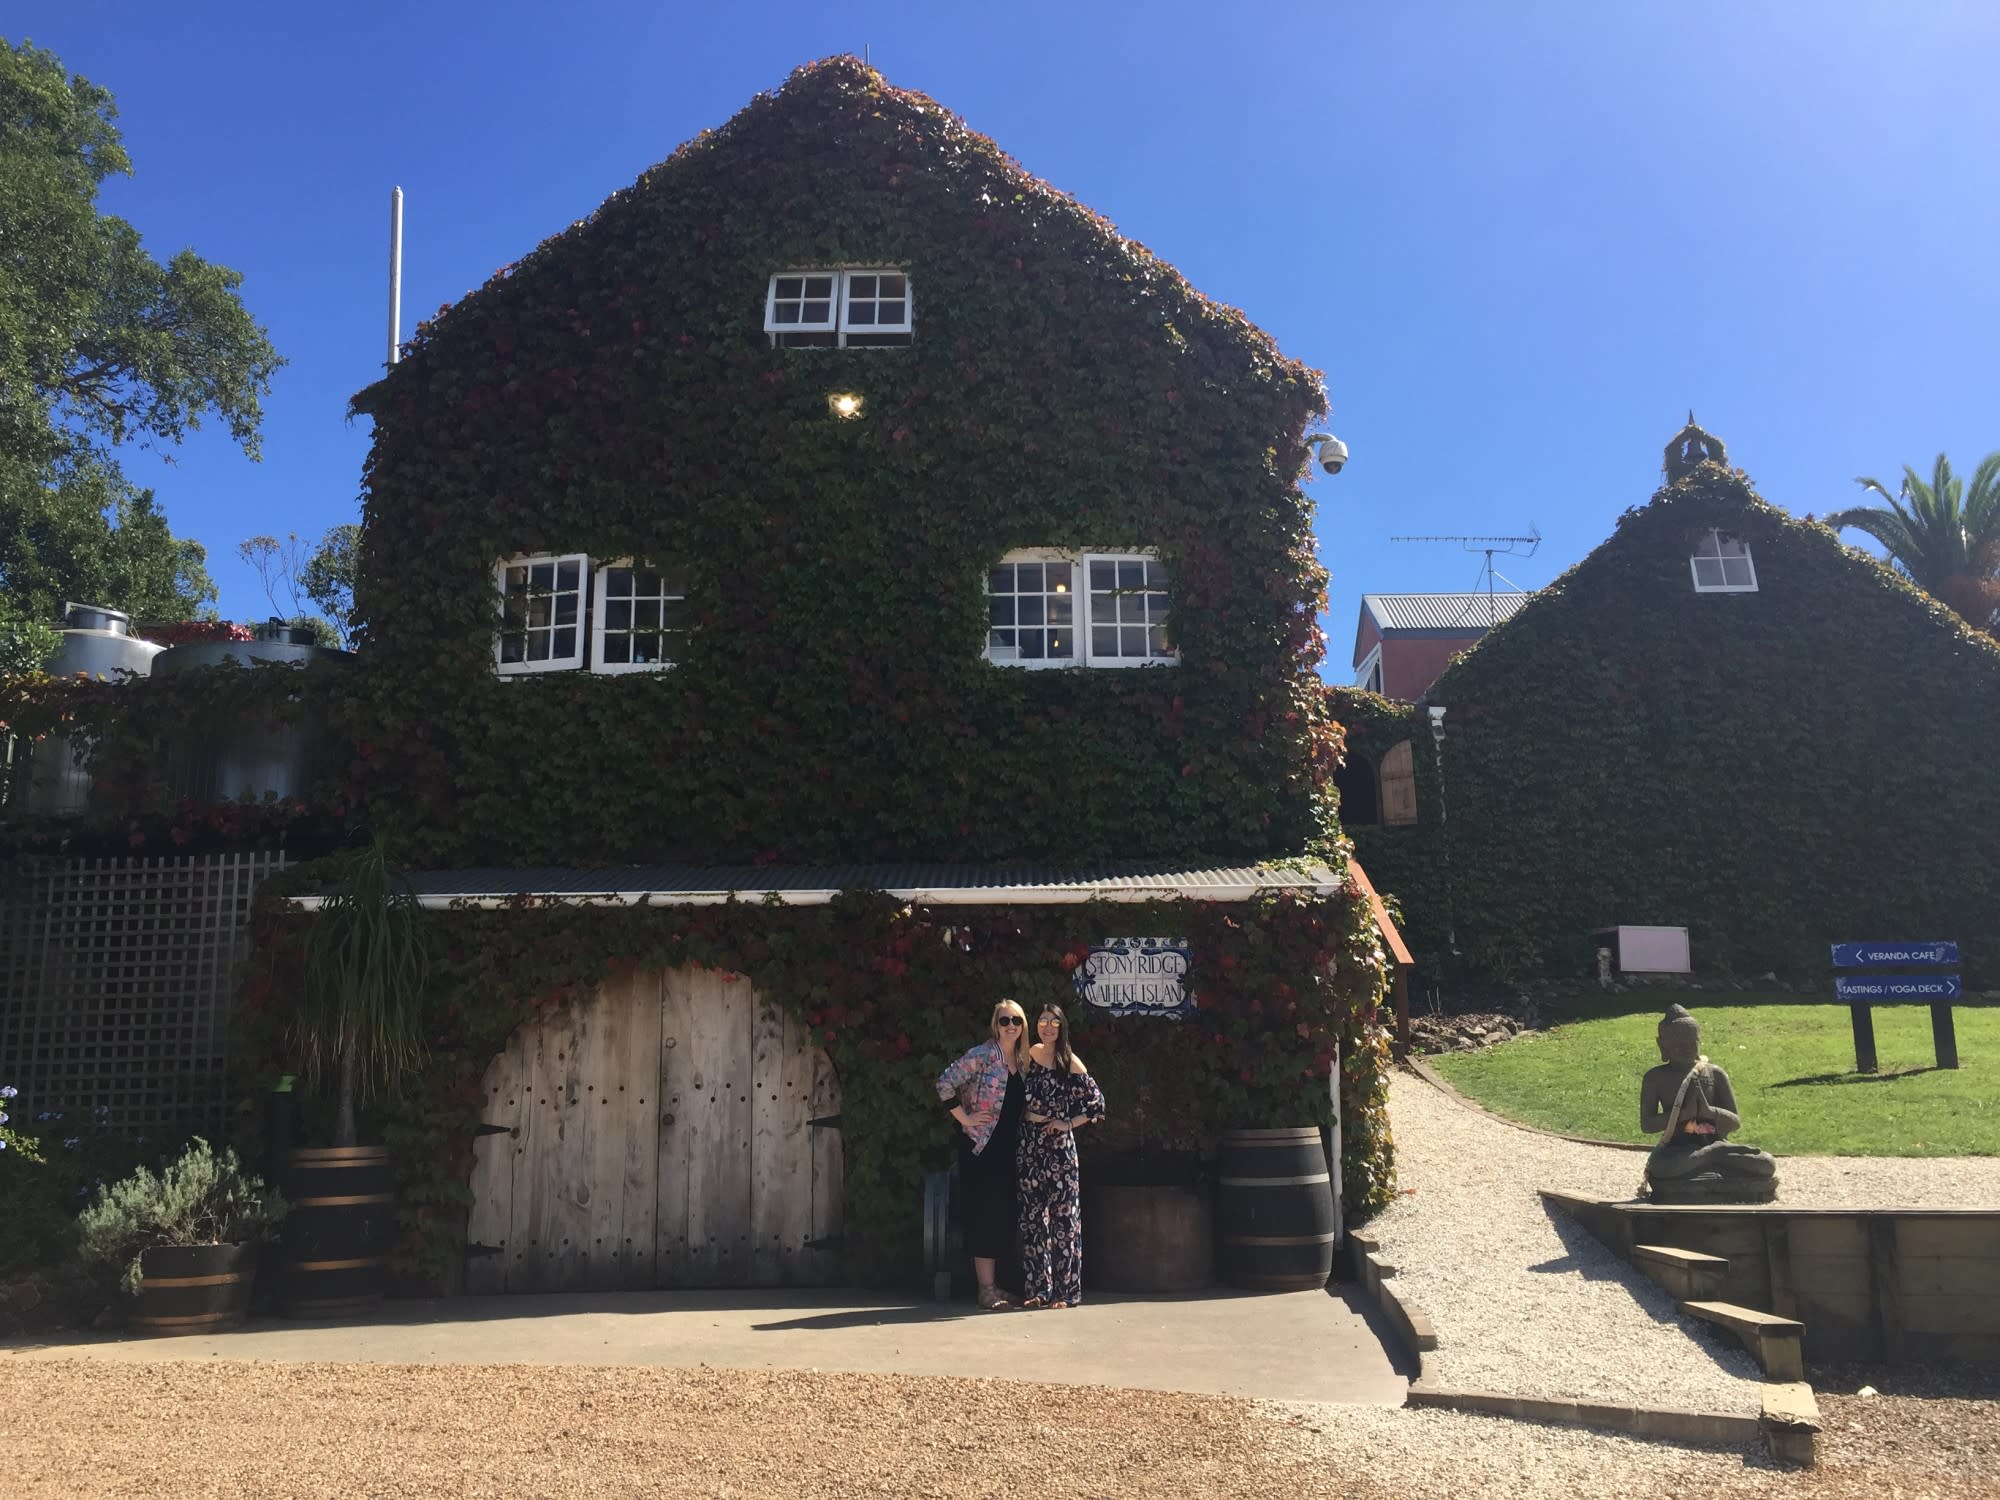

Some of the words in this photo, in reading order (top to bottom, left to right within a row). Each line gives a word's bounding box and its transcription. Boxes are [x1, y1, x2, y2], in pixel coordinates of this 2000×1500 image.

[1868, 952, 1910, 961] VERANDA
[1843, 985, 1882, 994] TASTINGS
[1889, 985, 1917, 993] YOGA
[1918, 984, 1944, 993] DECK
